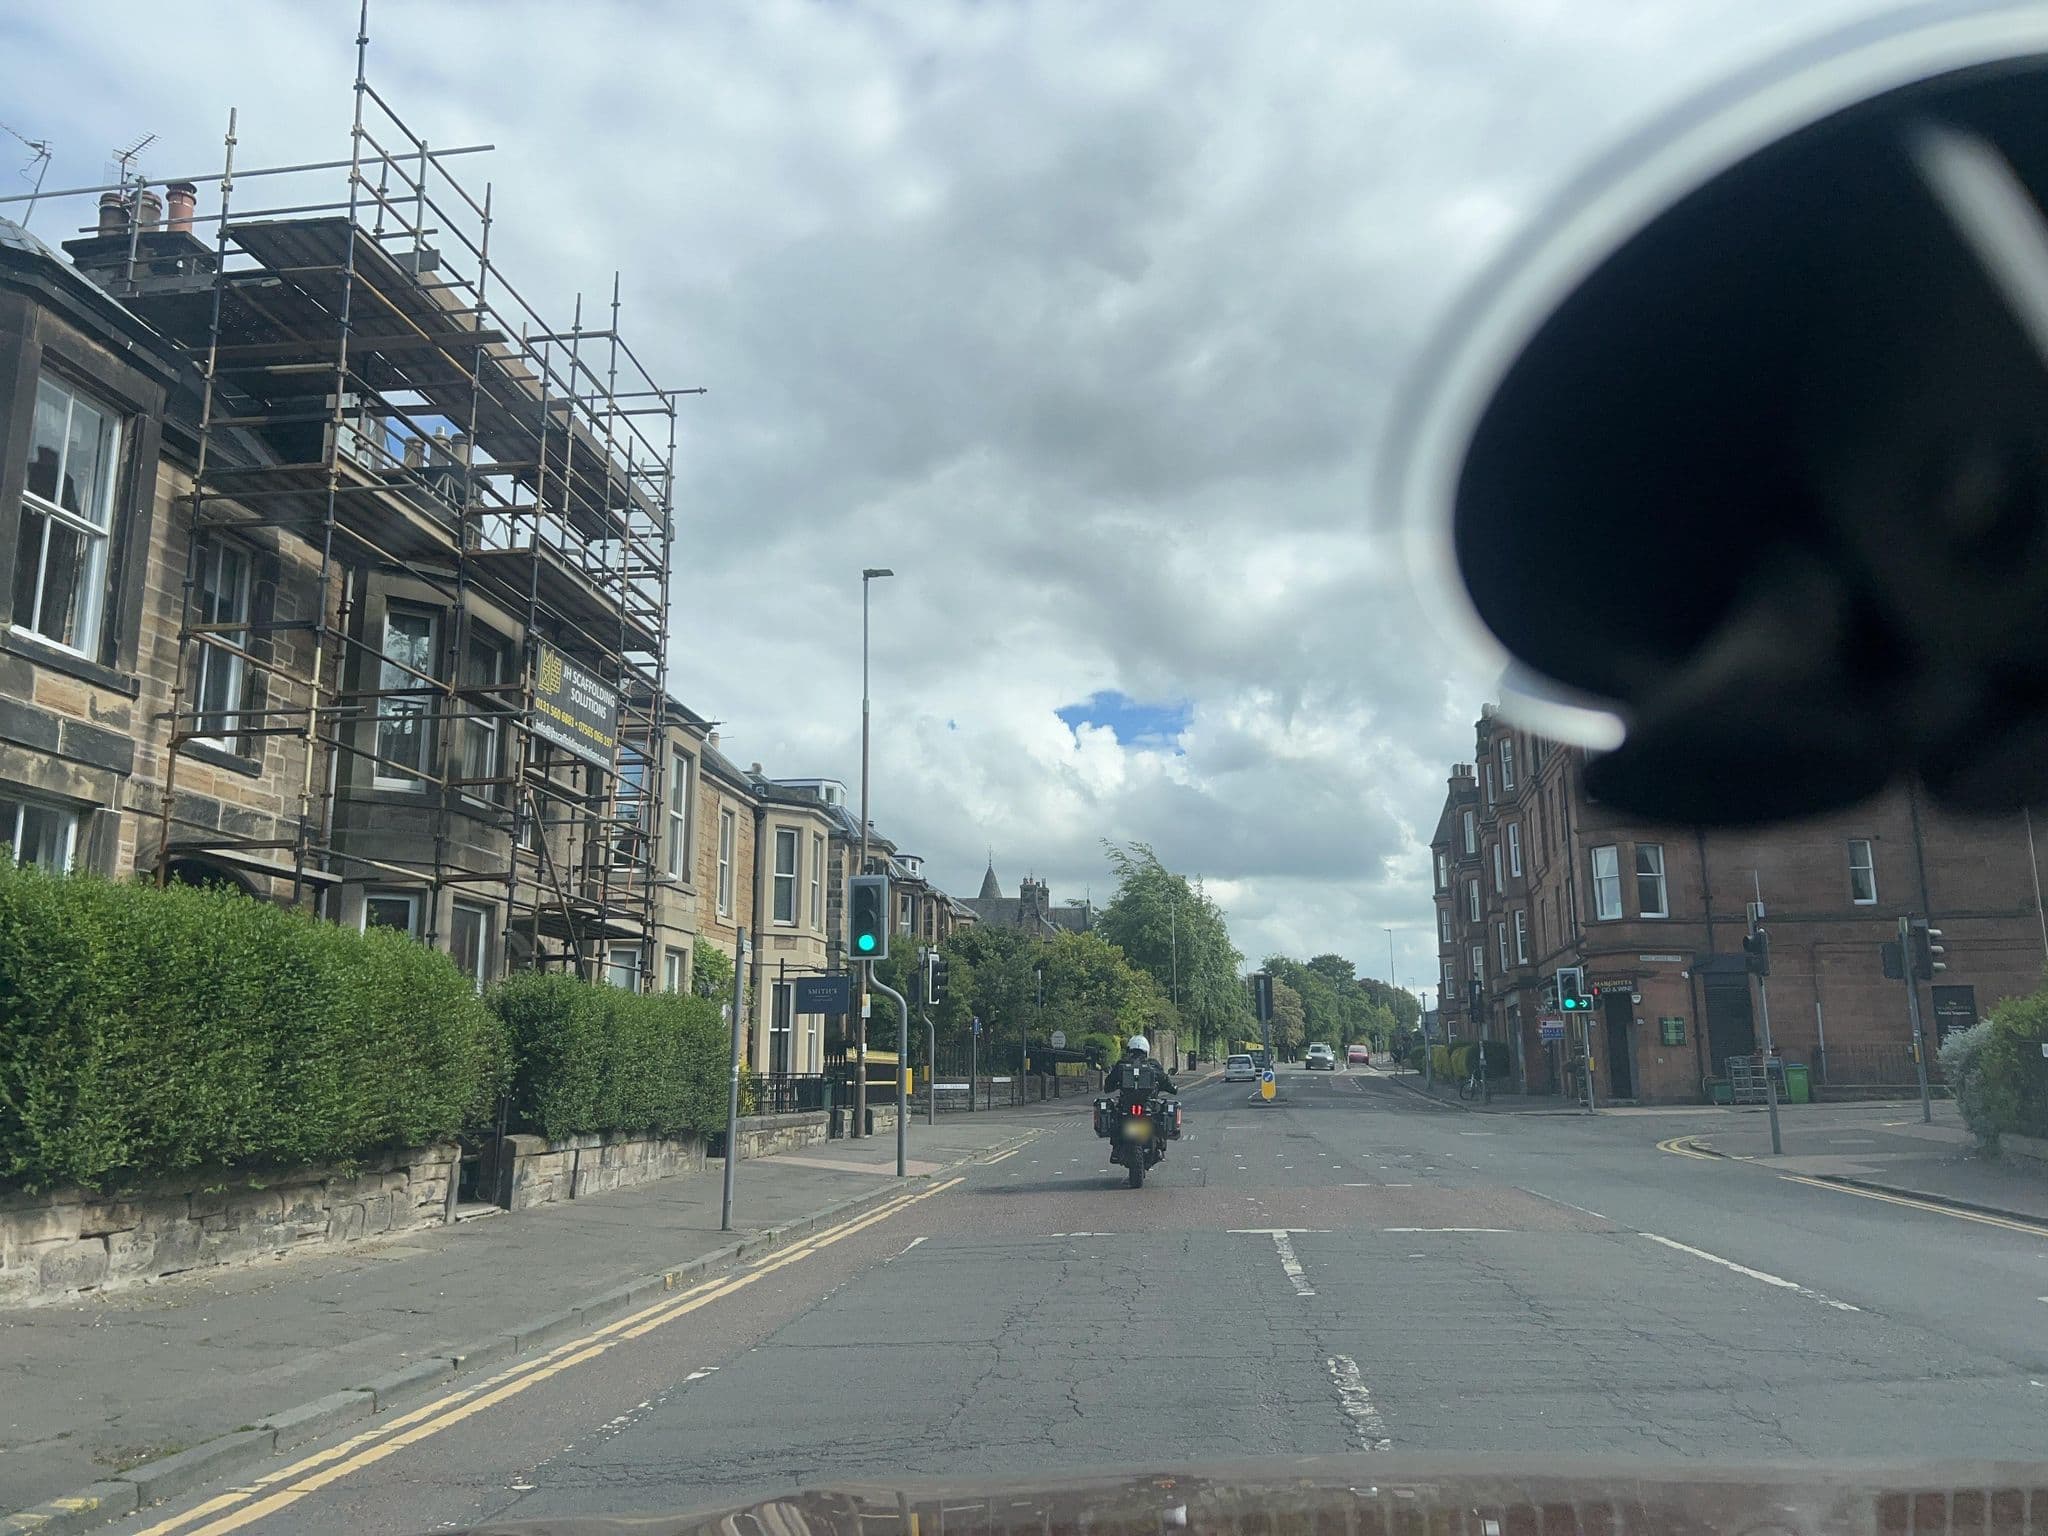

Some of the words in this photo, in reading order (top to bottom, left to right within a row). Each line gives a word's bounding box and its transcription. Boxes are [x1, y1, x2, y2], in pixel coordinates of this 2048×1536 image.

[563, 665, 572, 680] JH
[572, 671, 616, 708] SCAFFOLDING
[535, 697, 549, 713] 0131
[570, 687, 607, 719] SOLUTIONS
